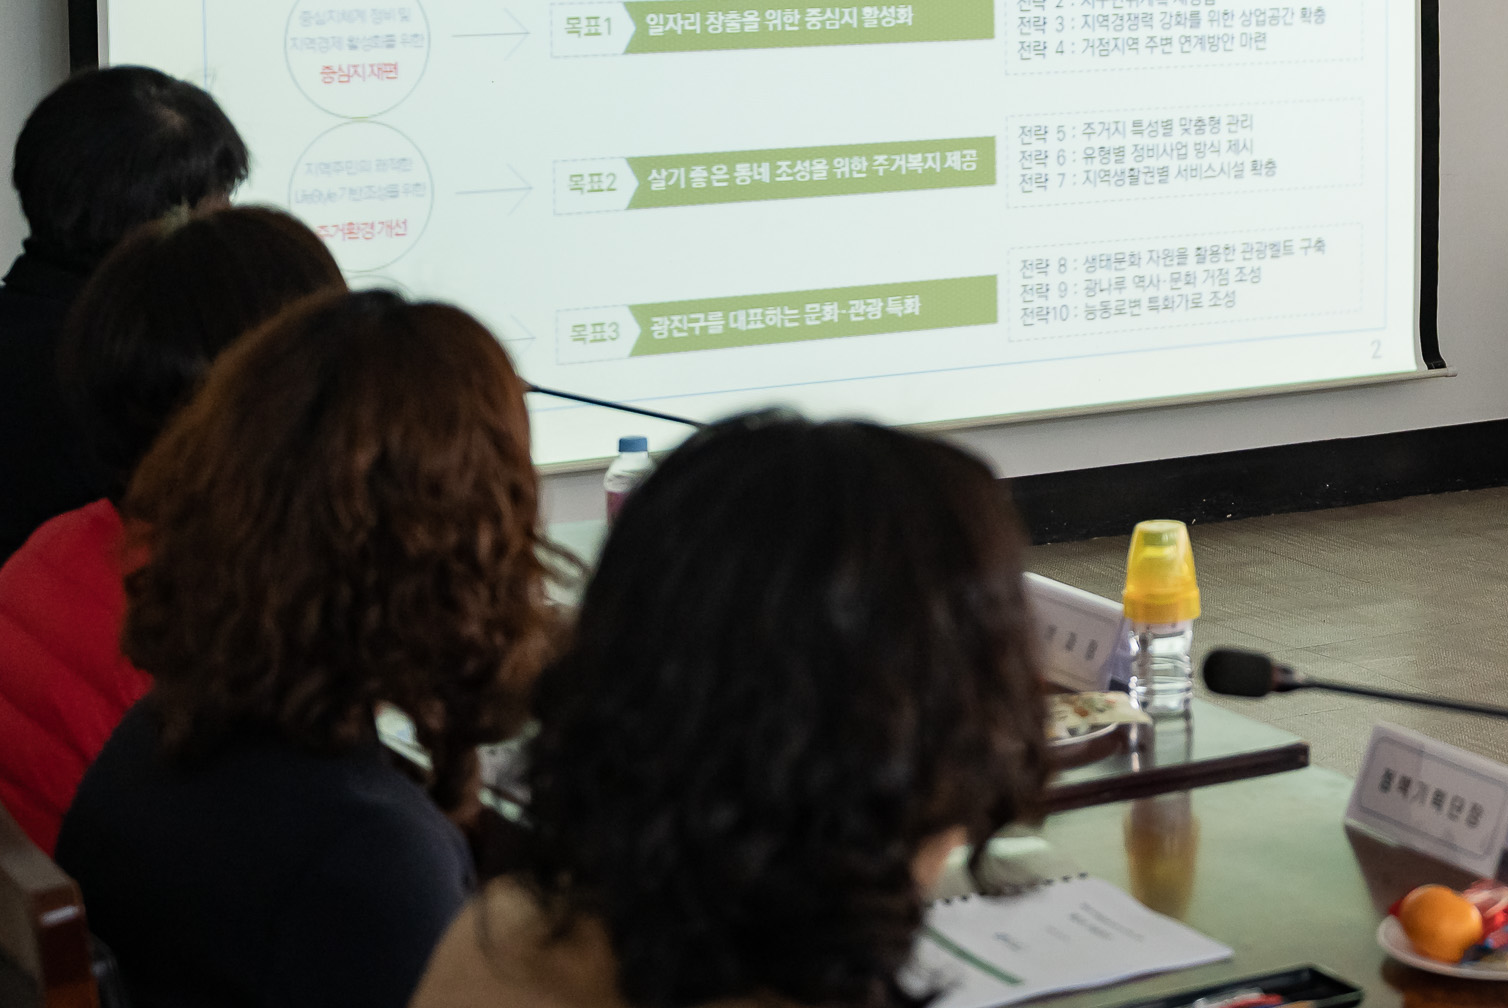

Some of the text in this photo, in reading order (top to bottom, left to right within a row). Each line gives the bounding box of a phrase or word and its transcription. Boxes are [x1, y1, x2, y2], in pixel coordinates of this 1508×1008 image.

[564, 16, 612, 37] 목표1
[646, 5, 914, 36] 일자리 창출을 위한 중심지 활성화
[1017, 5, 1326, 36] 전략 3 지역경쟁력 강화를 위한 상업공간 확충
[1017, 31, 1267, 61] 전략 4 거점지역 주변 연계방안 마련
[320, 64, 365, 84] 중심지
[1018, 113, 1253, 145] 전략 5 주거지 특성별 맞춤형 관리
[648, 149, 978, 190] 살기 좋은 동네 조성을 위한 주거복지 제공
[1018, 138, 1253, 170] 전략 6 유형별 정비사업 방식 제시
[568, 172, 617, 195] 목표2
[1018, 158, 1277, 193] 전략 7 지역생활권별 서비스시설 확충
[1019, 237, 1326, 278] 전략 8 생태문화 자원을 활용한 관광벨트 구축
[1020, 283, 1050, 302] 전략
[1058, 282, 1067, 298] 9
[1084, 278, 1127, 298] 광나루
[1202, 268, 1230, 286] 거점
[1234, 266, 1262, 284] 조성
[651, 313, 725, 340] 광진구를
[729, 307, 799, 332] 대표하는
[886, 295, 920, 317] 특화
[1020, 290, 1236, 326] 전략10 능동로변 특화가로 조성
[570, 322, 619, 345] 목표3
[1370, 340, 1382, 359] 2
